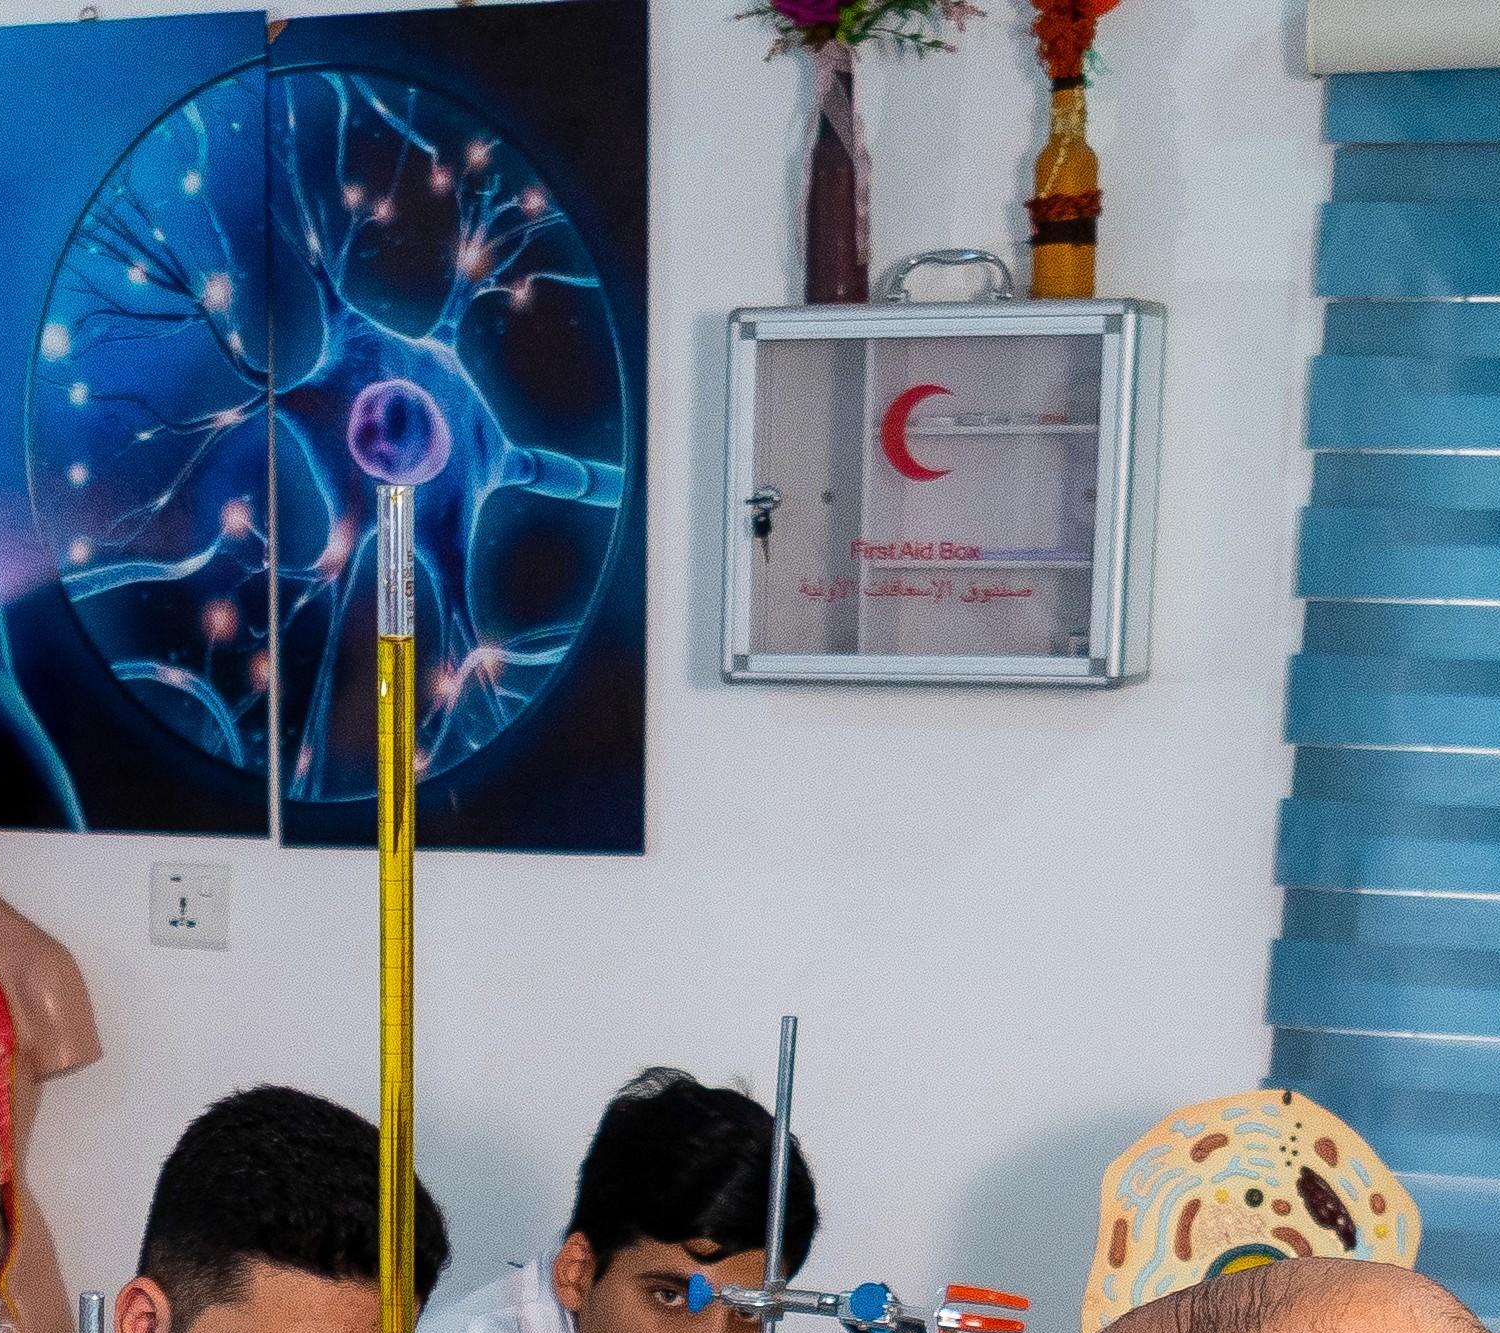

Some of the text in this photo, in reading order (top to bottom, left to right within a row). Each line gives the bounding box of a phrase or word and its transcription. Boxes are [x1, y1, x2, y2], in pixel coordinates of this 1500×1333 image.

[849, 541, 981, 561] First Aid Box
[960, 580, 1034, 604] صندوق
